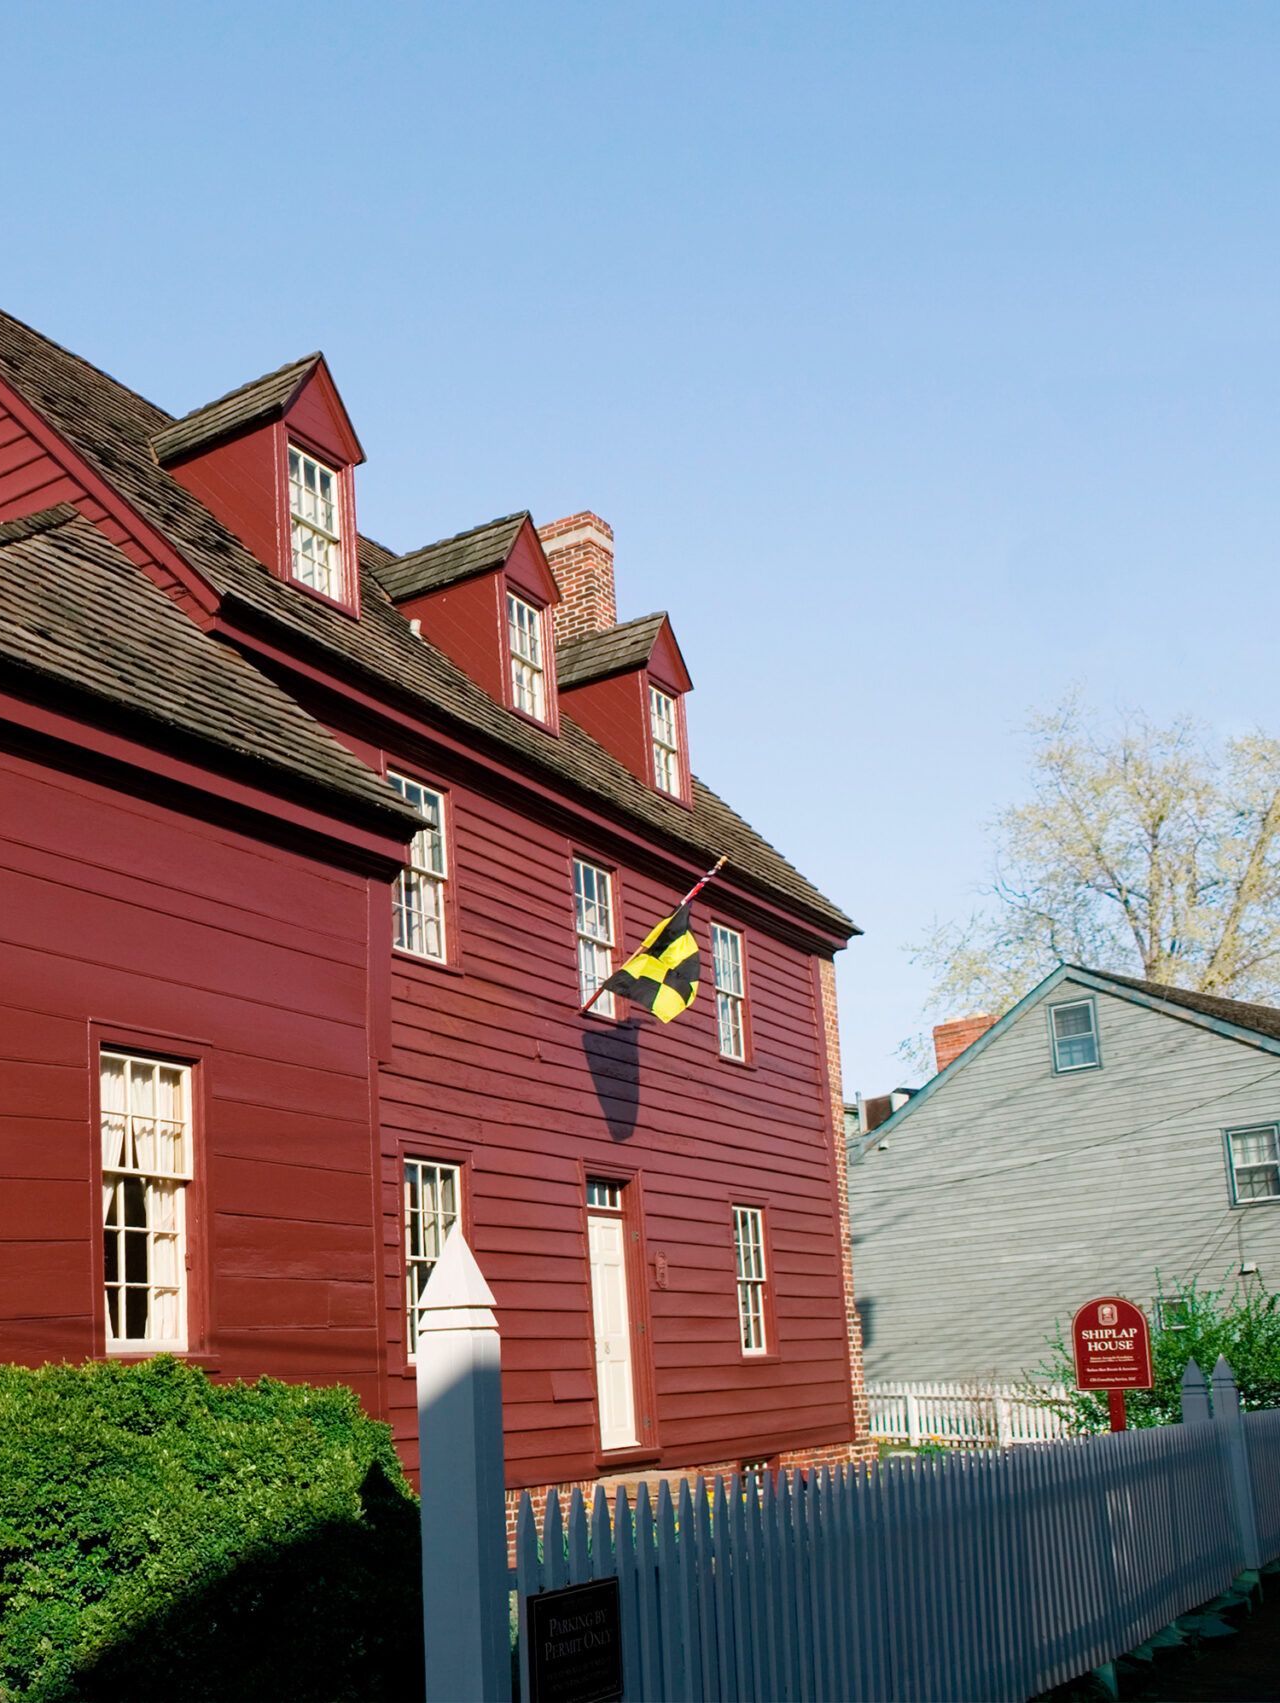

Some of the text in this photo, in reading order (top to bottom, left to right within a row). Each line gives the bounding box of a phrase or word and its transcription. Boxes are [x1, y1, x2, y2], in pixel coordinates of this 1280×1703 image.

[1081, 1328, 1137, 1340] SHIPLAP
[1088, 1340, 1134, 1351] HOUSE
[549, 1608, 609, 1637] PARKING BY
[544, 1629, 612, 1661] PERMIT ONLY
